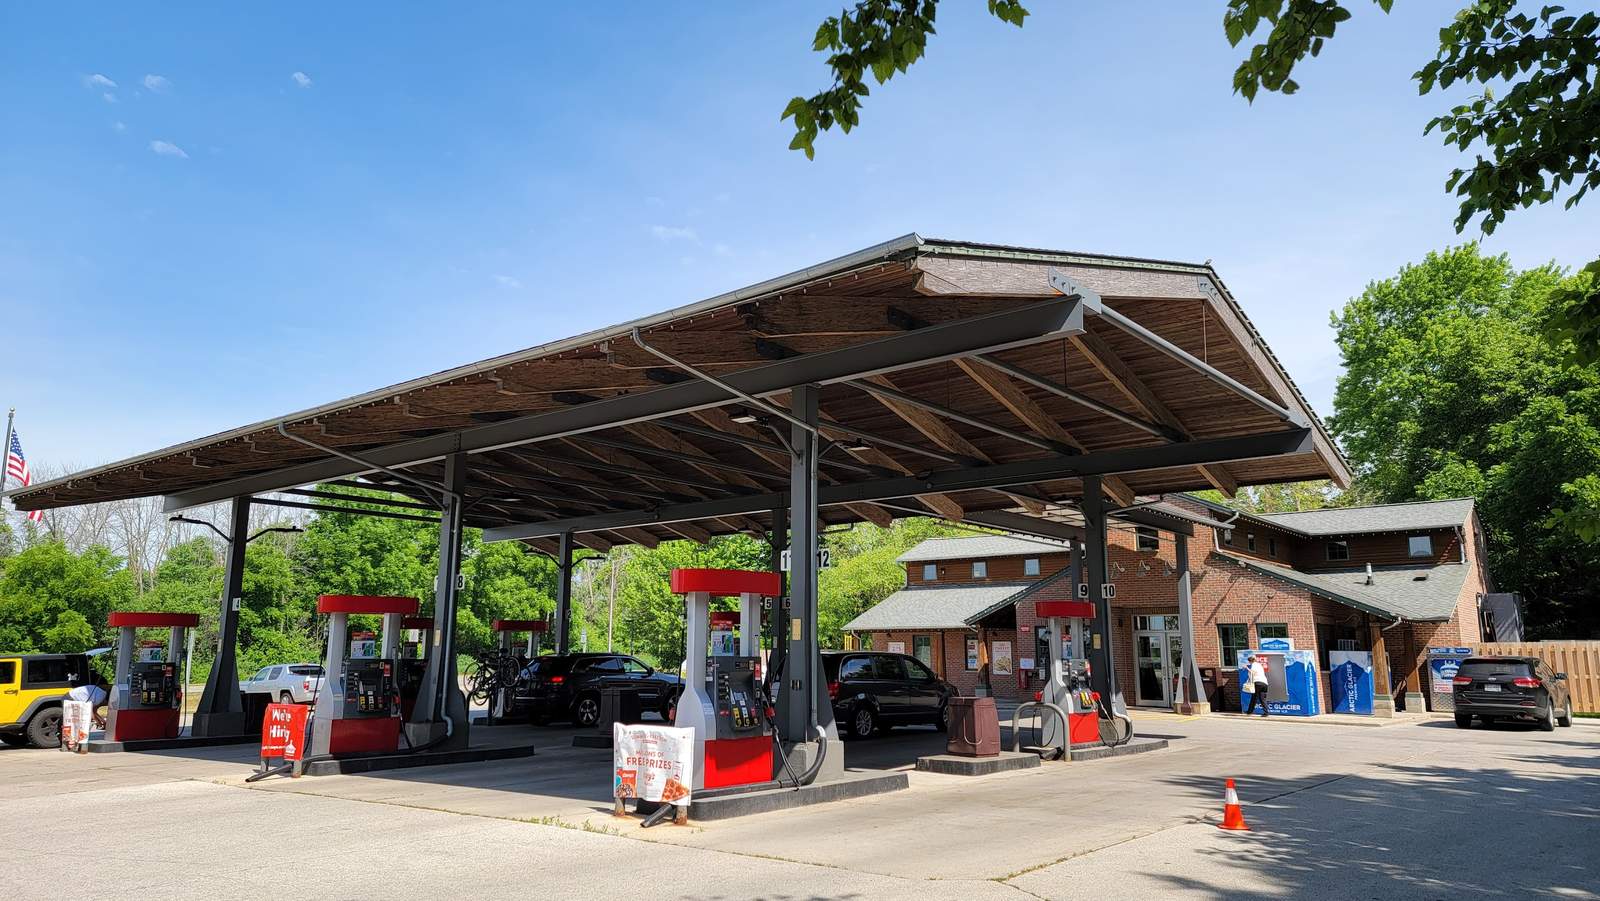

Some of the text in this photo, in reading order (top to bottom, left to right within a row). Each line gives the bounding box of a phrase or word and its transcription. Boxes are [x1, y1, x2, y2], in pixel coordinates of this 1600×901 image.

[782, 552, 792, 569] 1
[816, 550, 830, 567] 12
[457, 575, 464, 588] 8
[1080, 584, 1088, 596] 9
[1103, 585, 1115, 597] 10
[765, 598, 773, 608] 5
[645, 759, 672, 770] PRIZES
